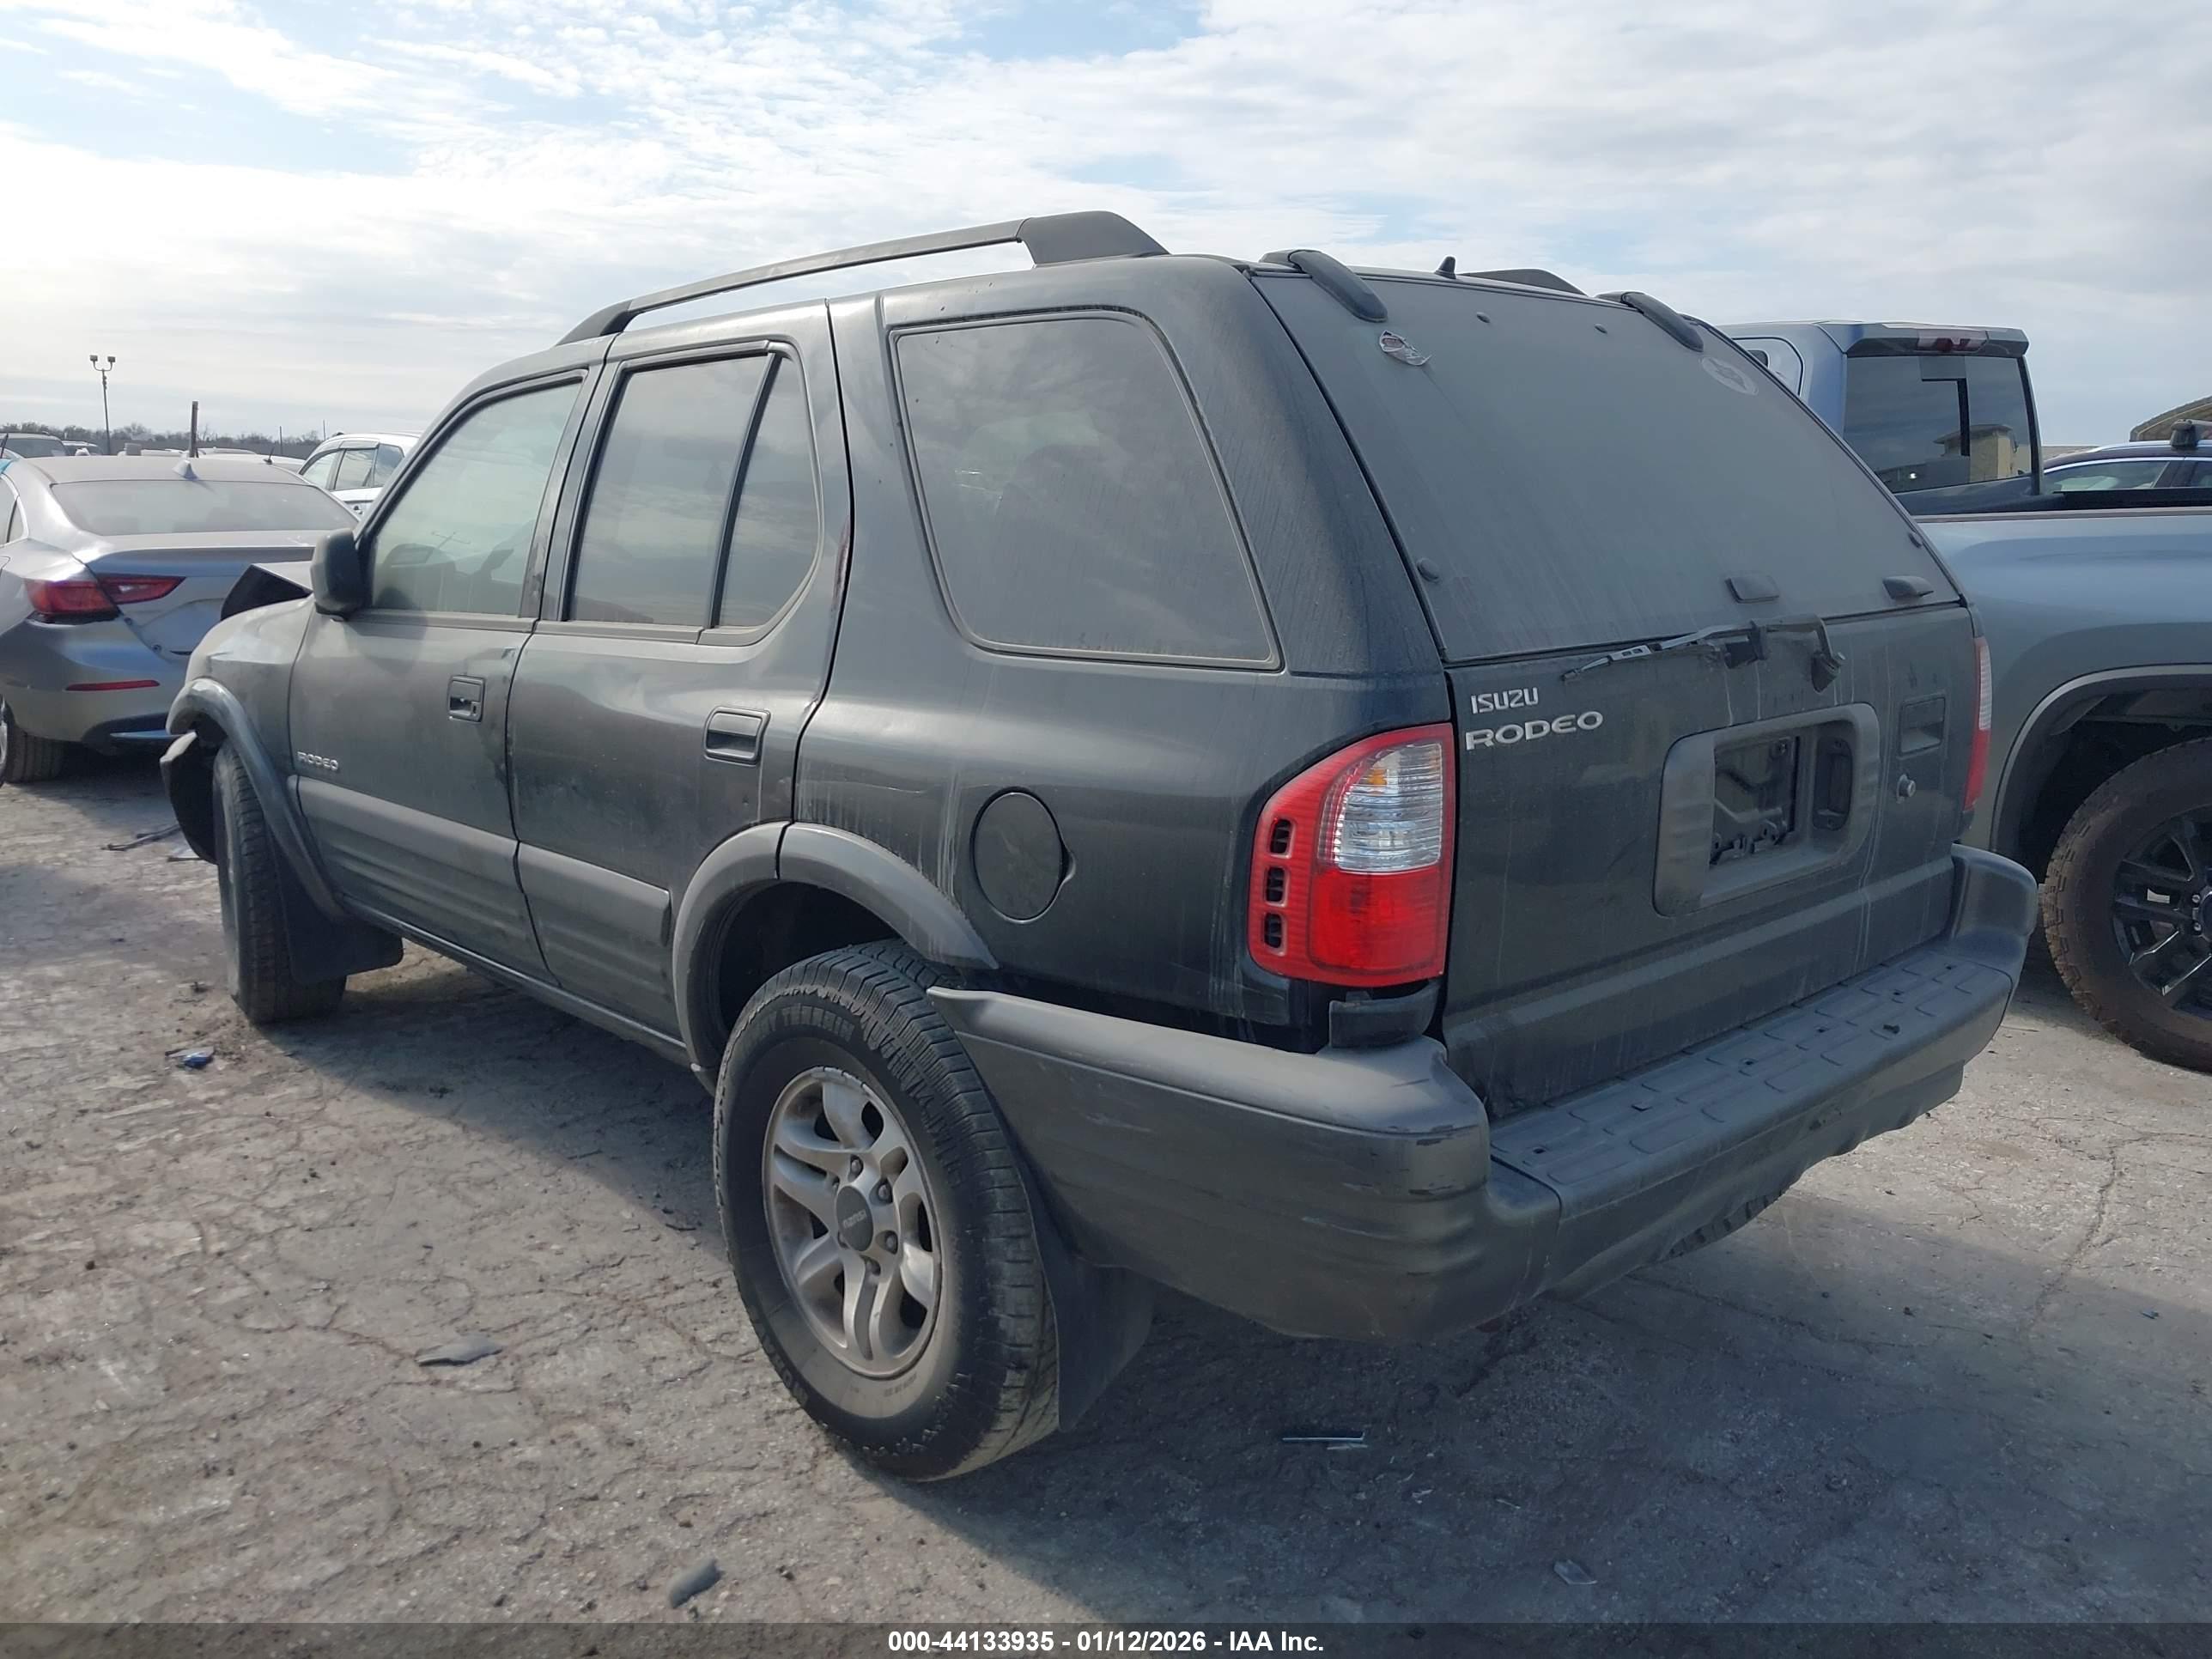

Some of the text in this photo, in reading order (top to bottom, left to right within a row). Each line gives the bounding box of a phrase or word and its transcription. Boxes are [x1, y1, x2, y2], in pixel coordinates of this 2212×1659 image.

[1470, 687, 1540, 714] ISUZU
[1465, 711, 1603, 750] RODEO
[297, 750, 339, 771] RODEO
